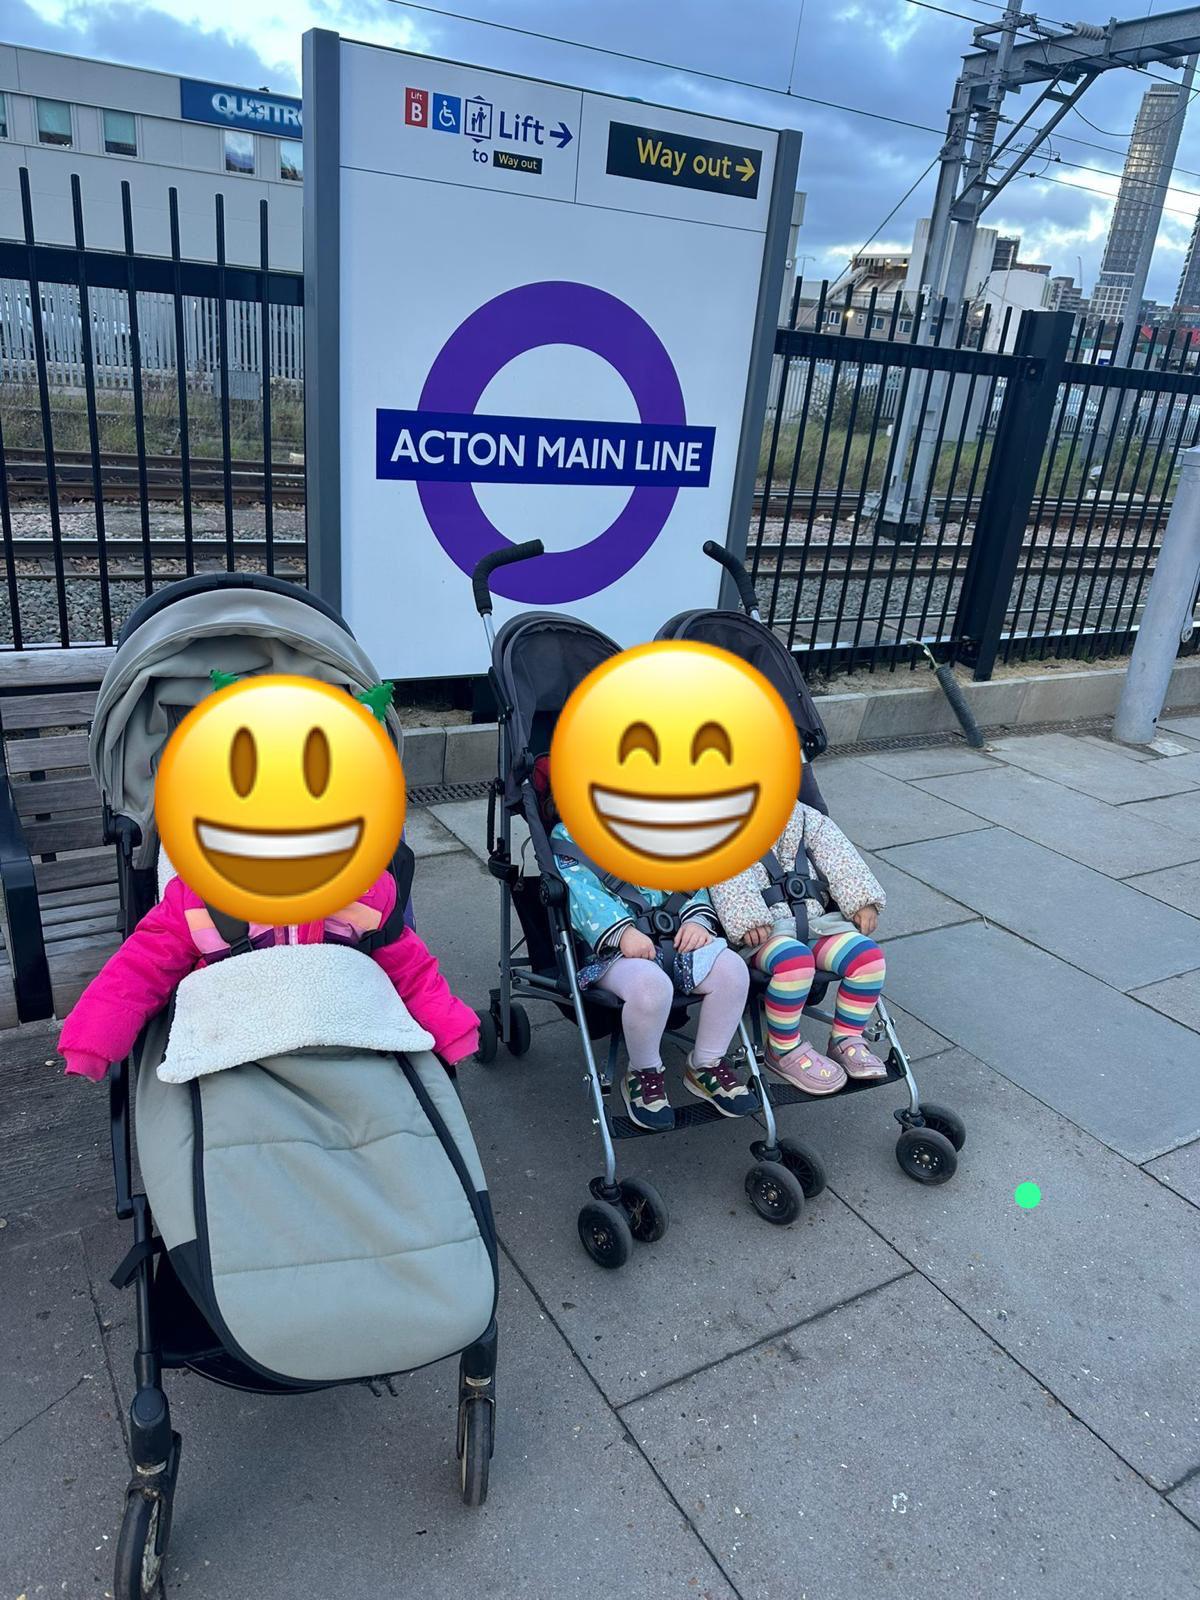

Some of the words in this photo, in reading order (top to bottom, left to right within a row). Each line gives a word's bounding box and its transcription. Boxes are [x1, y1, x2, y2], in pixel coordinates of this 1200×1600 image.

[411, 91, 423, 101] Lift
[411, 102, 423, 122] B
[499, 111, 545, 145] Lift
[472, 148, 489, 163] to
[498, 153, 519, 168] Way
[521, 158, 538, 170] out
[637, 136, 686, 176] Way
[693, 155, 732, 179] out
[390, 428, 525, 467] ACTON
[537, 436, 626, 470] MAIN
[635, 440, 703, 472] LINE
